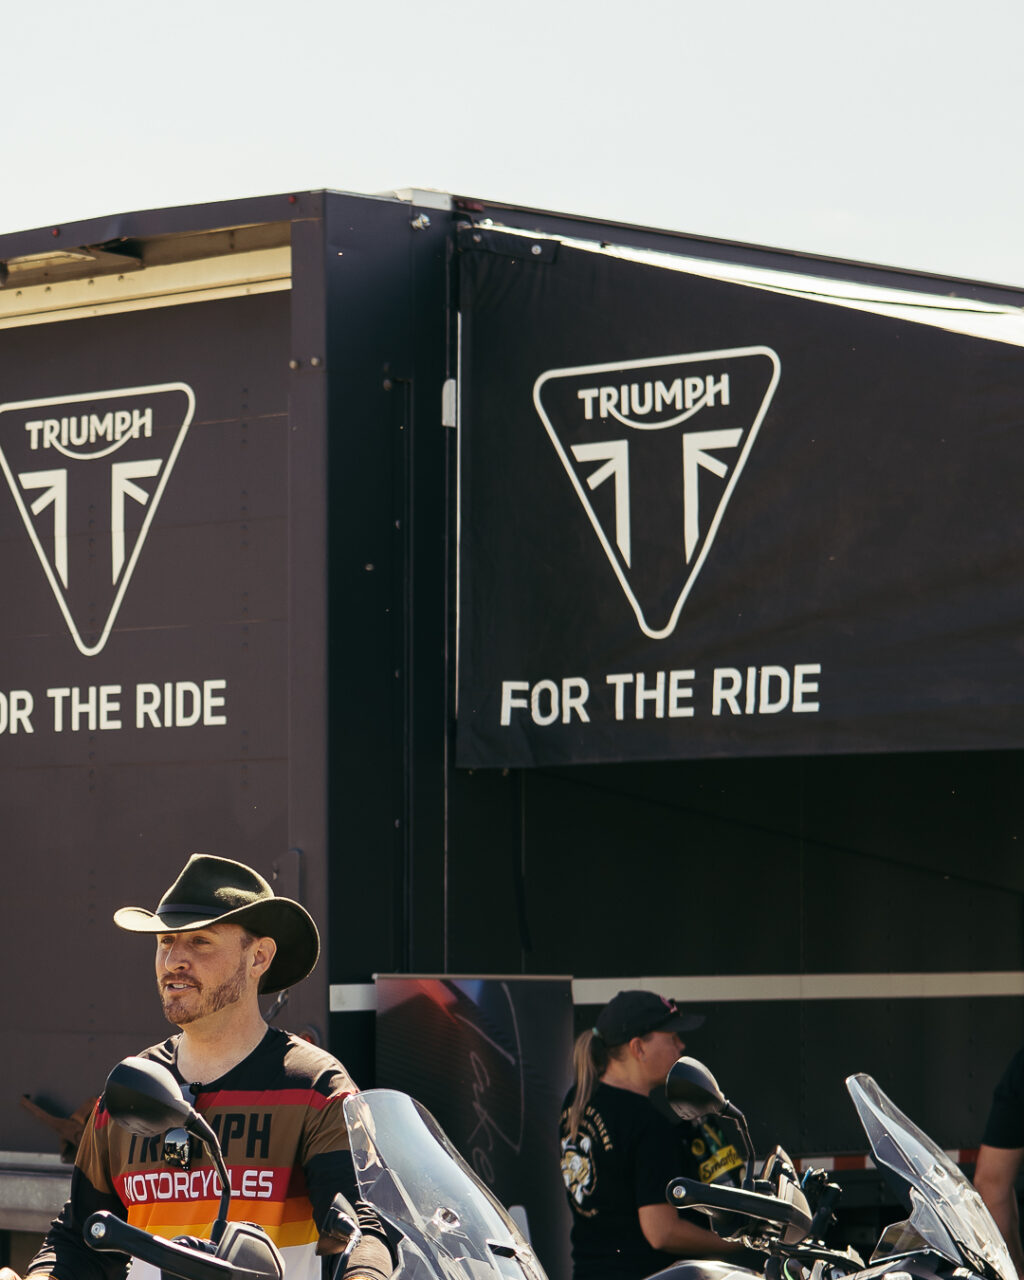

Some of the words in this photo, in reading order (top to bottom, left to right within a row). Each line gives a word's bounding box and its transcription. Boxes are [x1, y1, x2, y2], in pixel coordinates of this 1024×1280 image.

[577, 373, 731, 430] TRIUMPH
[25, 407, 153, 460] TRIUMPH
[46, 684, 123, 732] THE
[136, 679, 227, 729] RIDE
[500, 676, 591, 727] FOR
[606, 669, 696, 720] THE
[712, 663, 821, 716] RIDE
[123, 1168, 275, 1202] MOTORCYCLES
